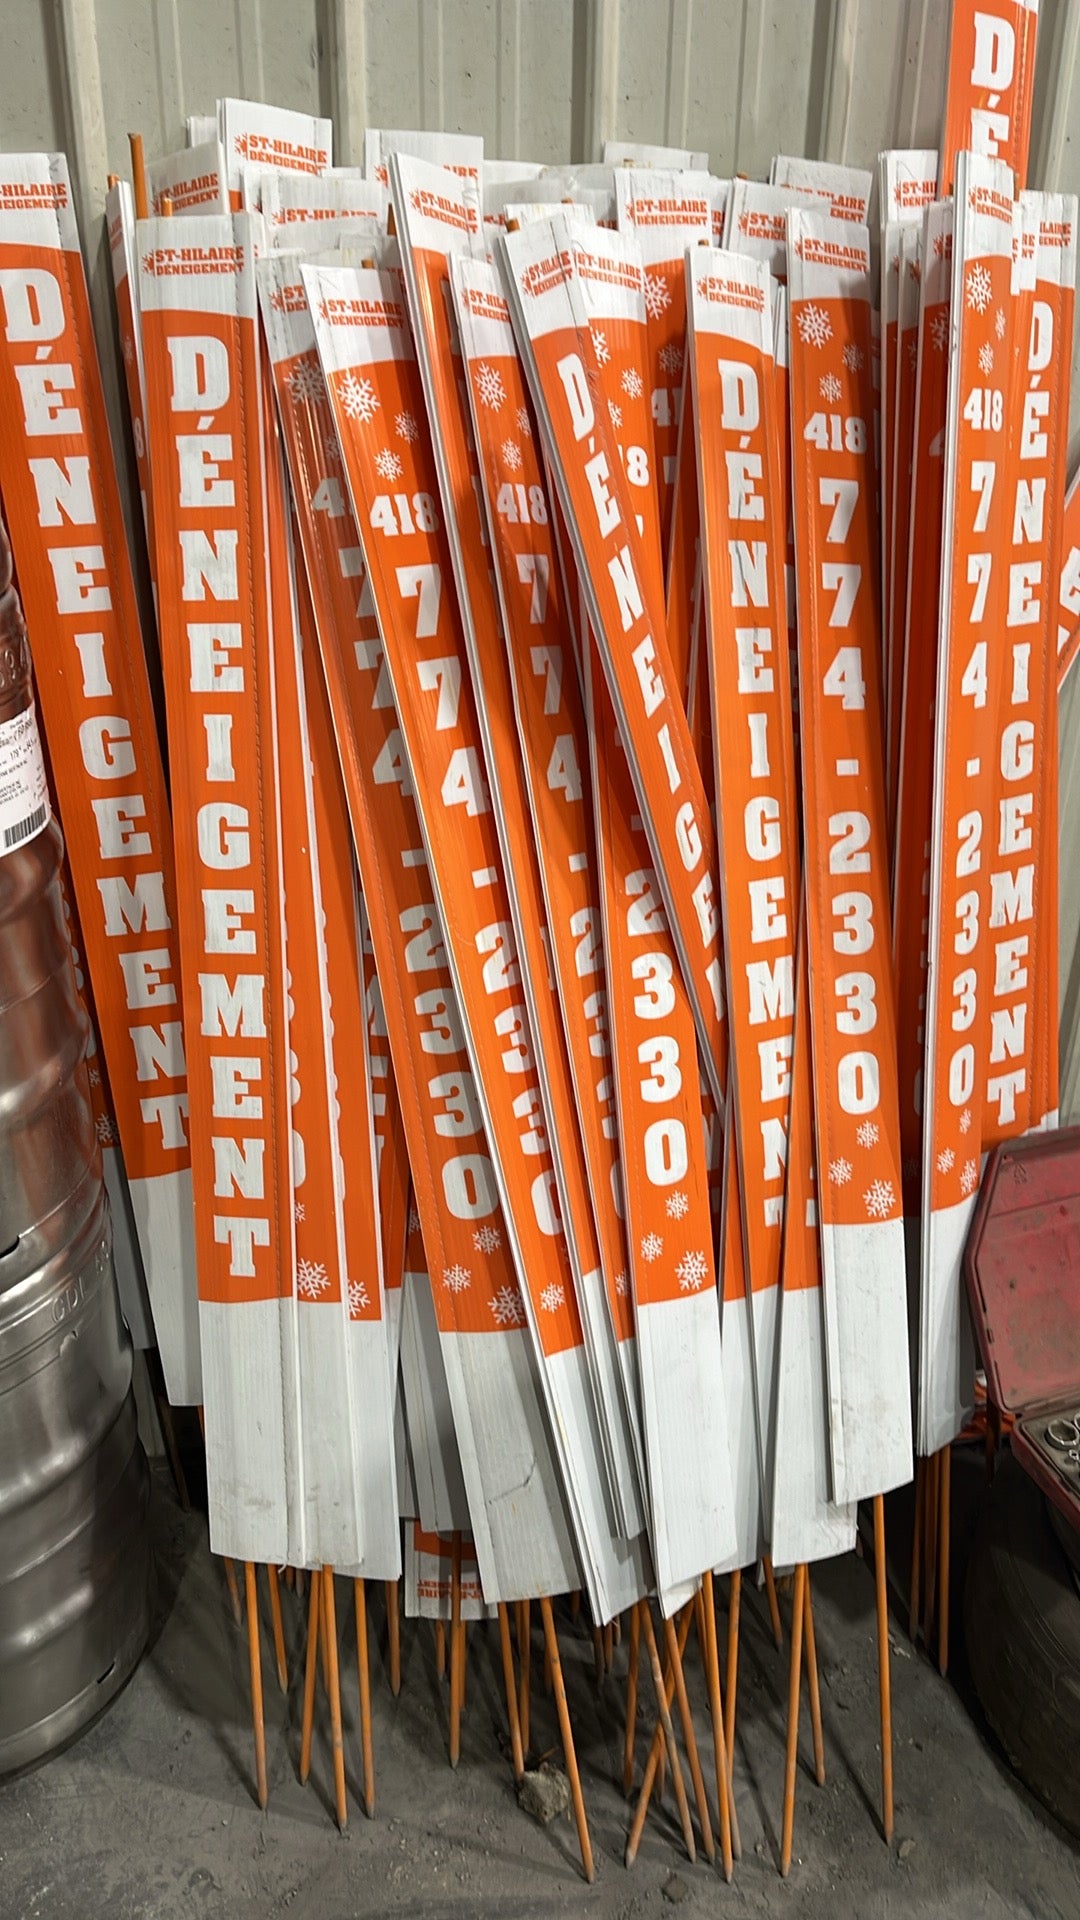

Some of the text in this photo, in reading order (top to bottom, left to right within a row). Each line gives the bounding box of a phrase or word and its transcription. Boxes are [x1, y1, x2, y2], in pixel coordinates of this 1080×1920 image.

[249, 133, 327, 165] ST-HILAIRE
[0, 183, 66, 196] HILAIRE
[0, 199, 68, 209] EIGEMENT
[902, 181, 937, 194] ST-HI
[636, 199, 707, 214] ST-HILAIRE
[1039, 221, 1071, 235] ILAIRE
[154, 246, 244, 263] ST-HILAIRE
[804, 237, 867, 261] ST-HILAIRE
[328, 299, 403, 316] ST-HILAIRE
[708, 276, 765, 302] ST-HILAIRE
[963, 387, 1004, 433] 418
[803, 412, 868, 454] 418
[369, 493, 438, 536] 418
[497, 483, 548, 526] 418
[557, 352, 726, 1022] DÉNEIGE
[0, 267, 188, 1151] DÉNEIGEMENT
[987, 301, 1054, 1126] DÉNEIGEMENT
[818, 477, 880, 1116] 774-2330
[948, 460, 997, 1107] 774-2330
[166, 335, 270, 1278] DÉNEIGEMENT
